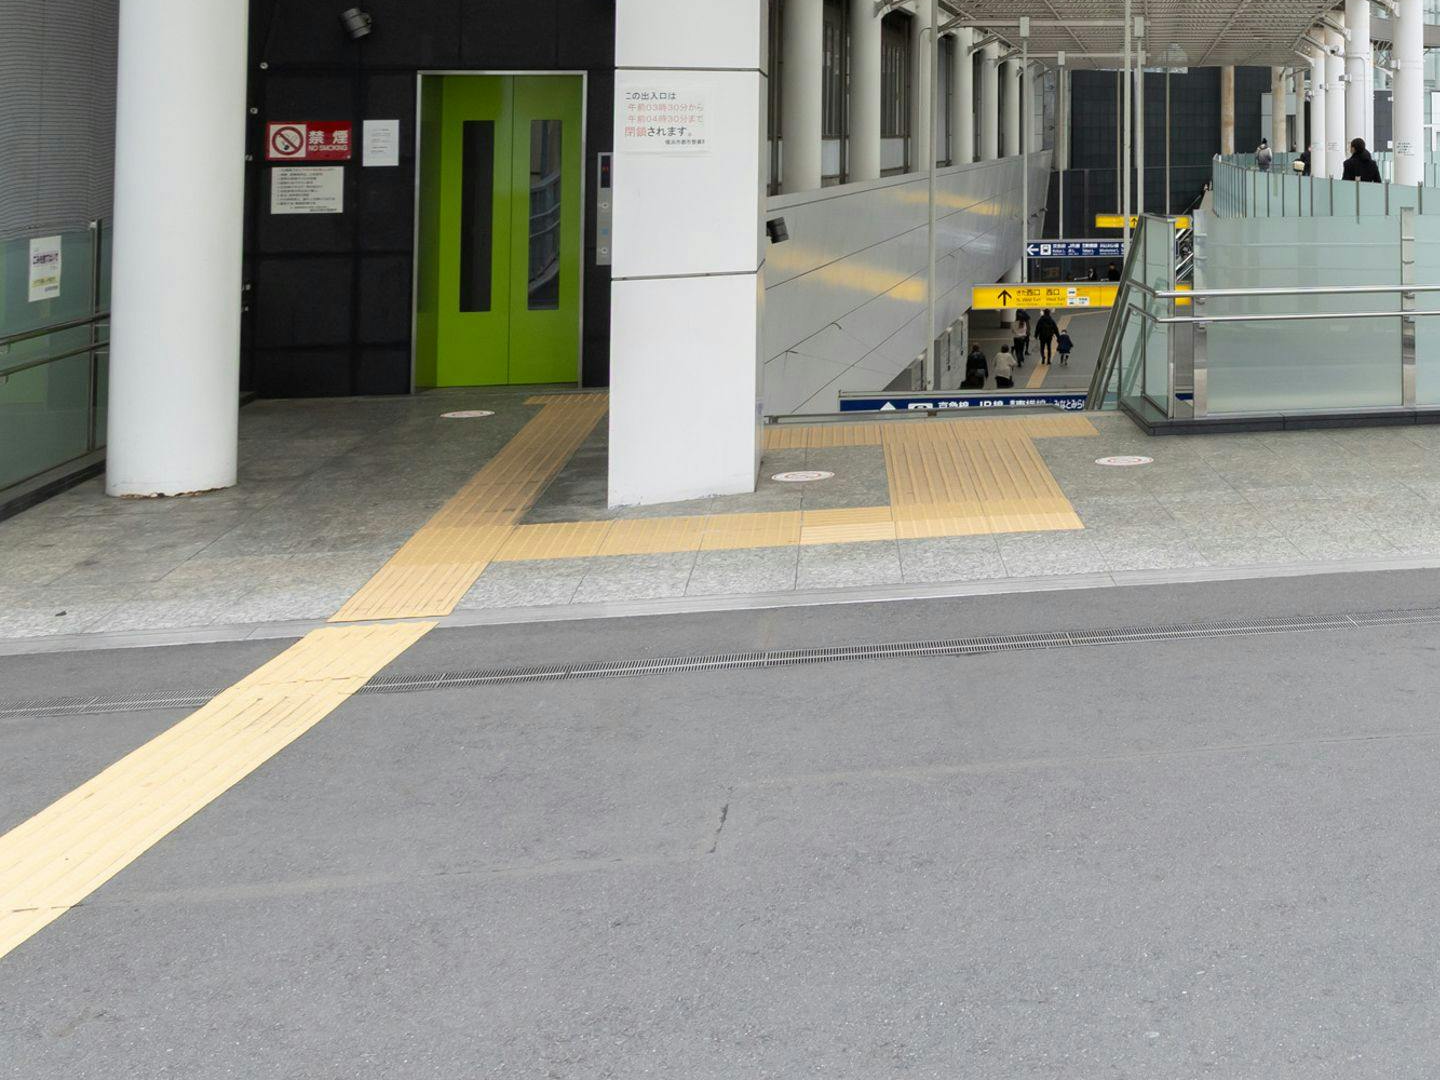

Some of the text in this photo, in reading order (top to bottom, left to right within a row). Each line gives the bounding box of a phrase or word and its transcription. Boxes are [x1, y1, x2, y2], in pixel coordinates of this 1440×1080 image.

[625, 91, 677, 100] この出入口は
[309, 130, 348, 144] 禁煙
